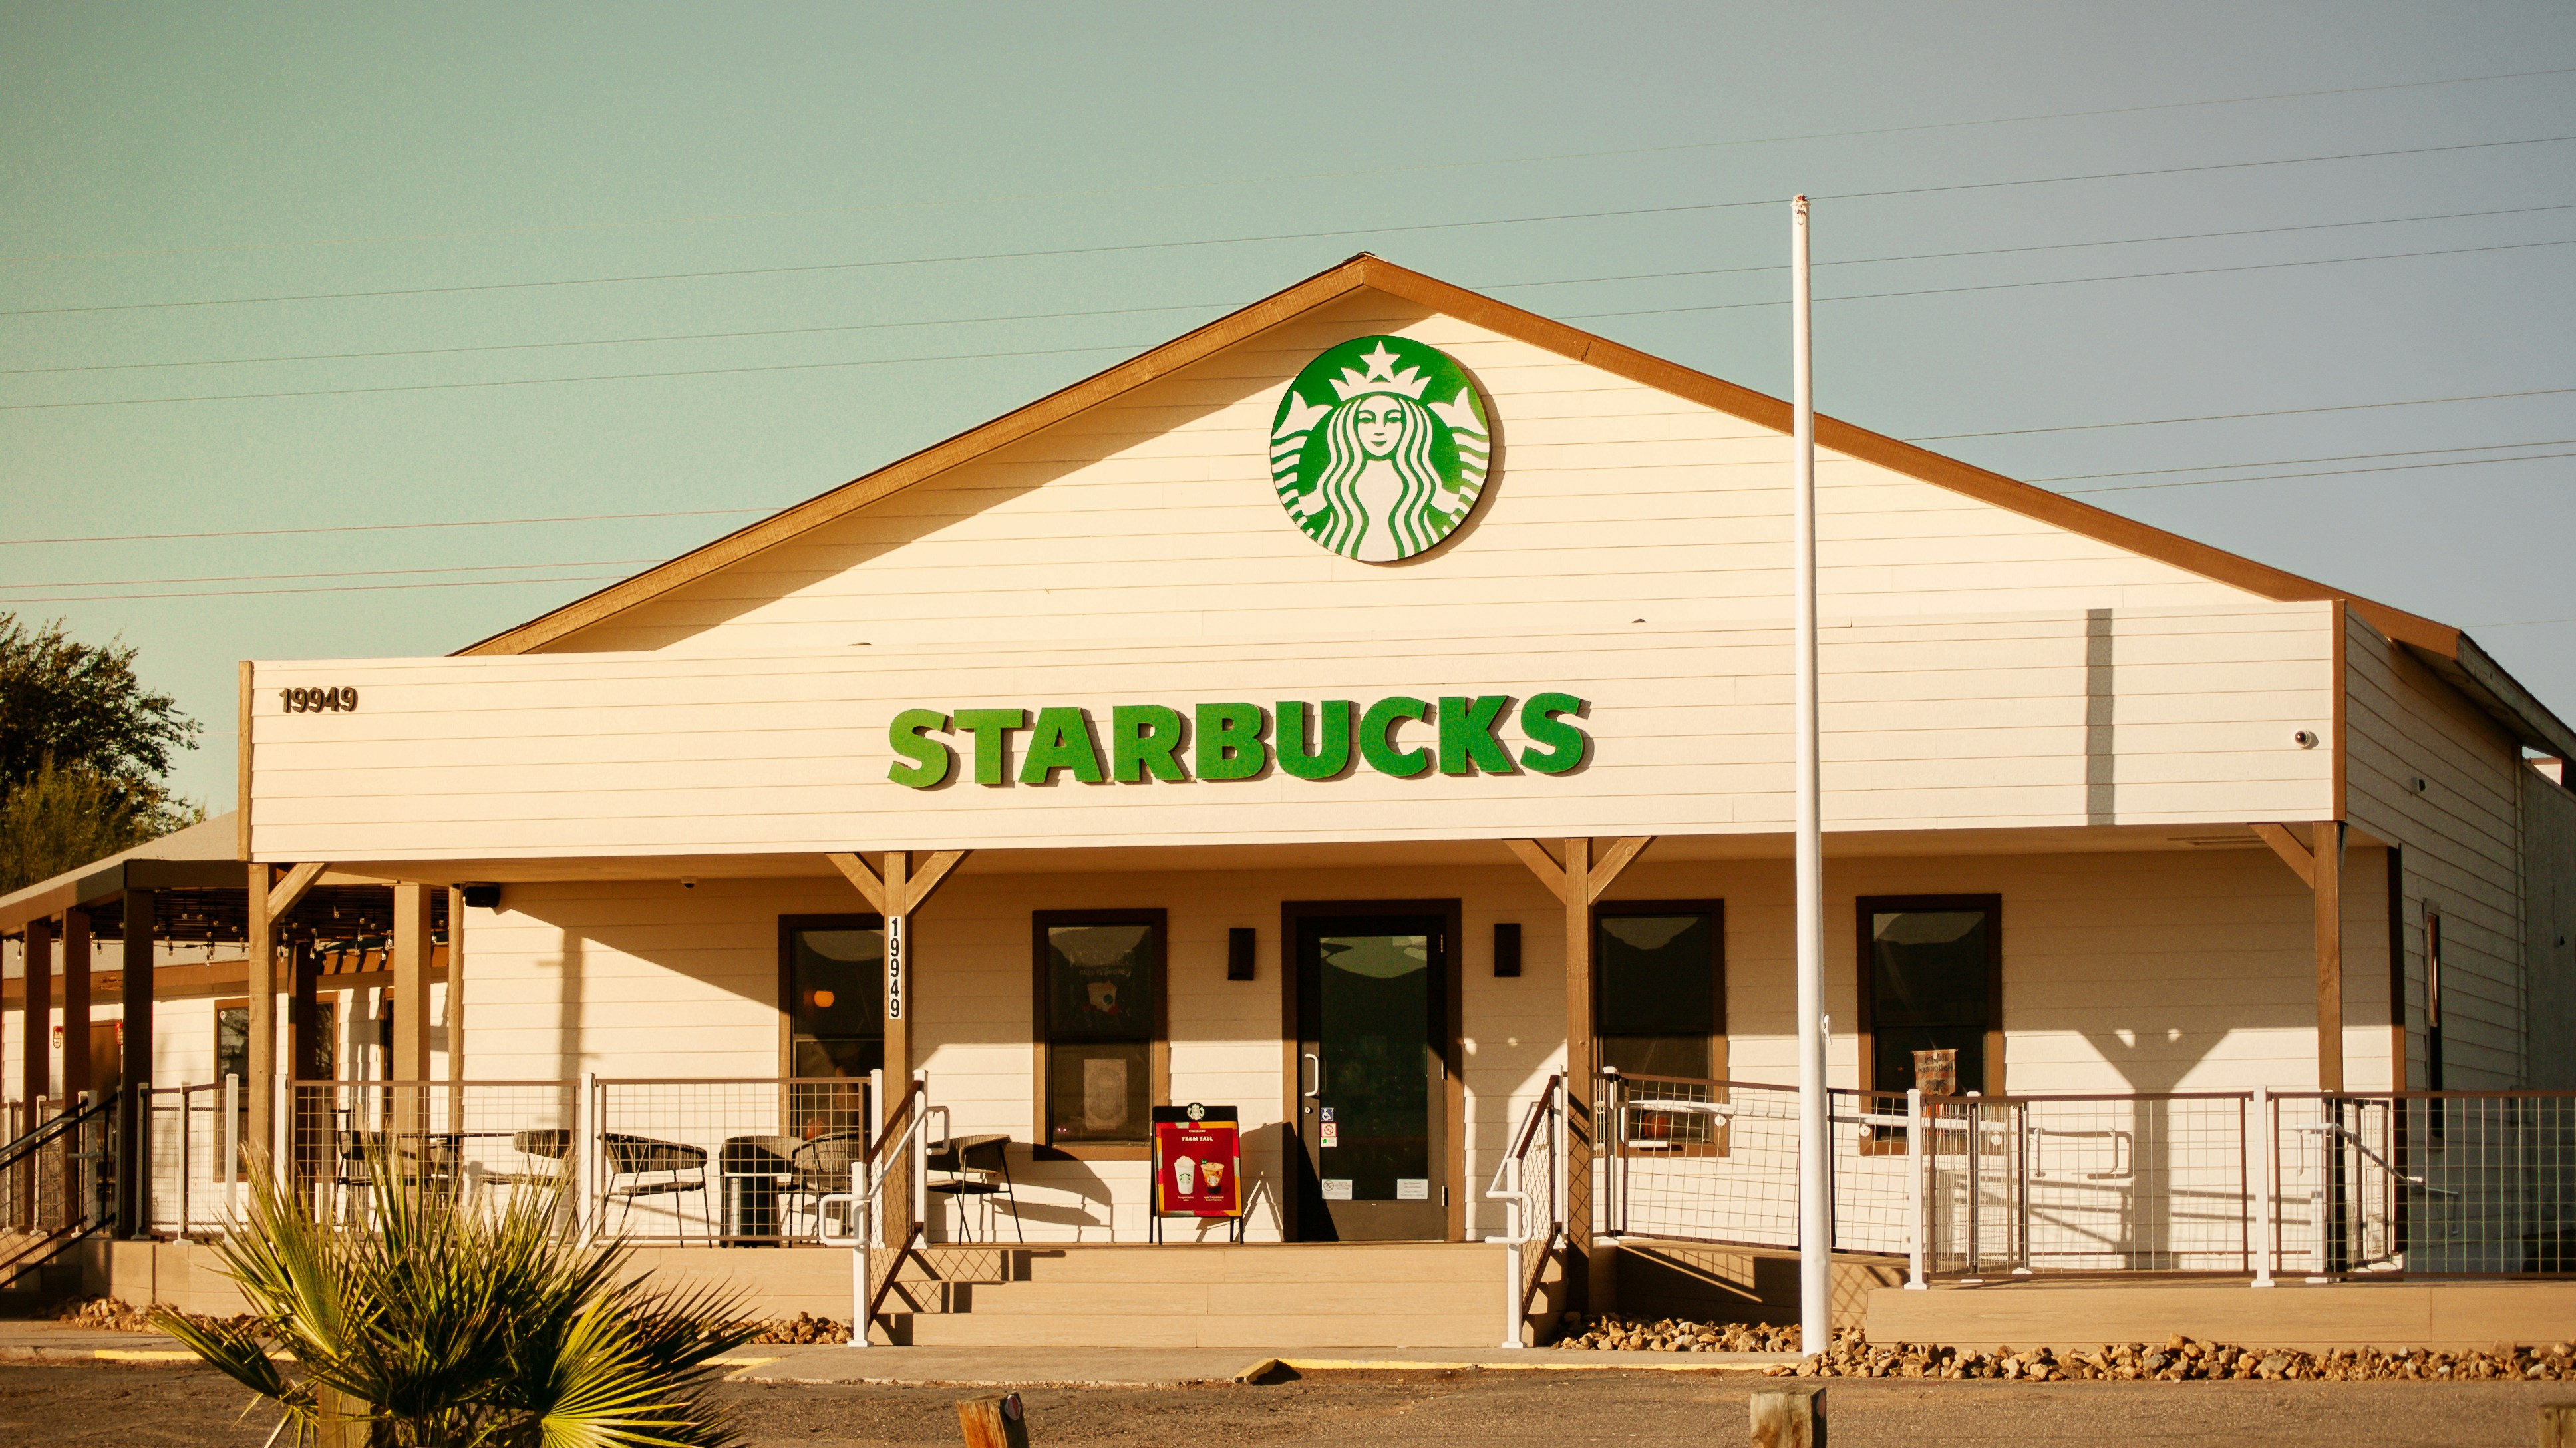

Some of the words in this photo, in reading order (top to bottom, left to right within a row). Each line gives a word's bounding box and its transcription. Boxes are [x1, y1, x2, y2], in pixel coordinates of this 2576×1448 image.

[279, 686, 359, 713] 19949
[887, 692, 1585, 788] STARBUCKS
[890, 918, 899, 1018] 19949
